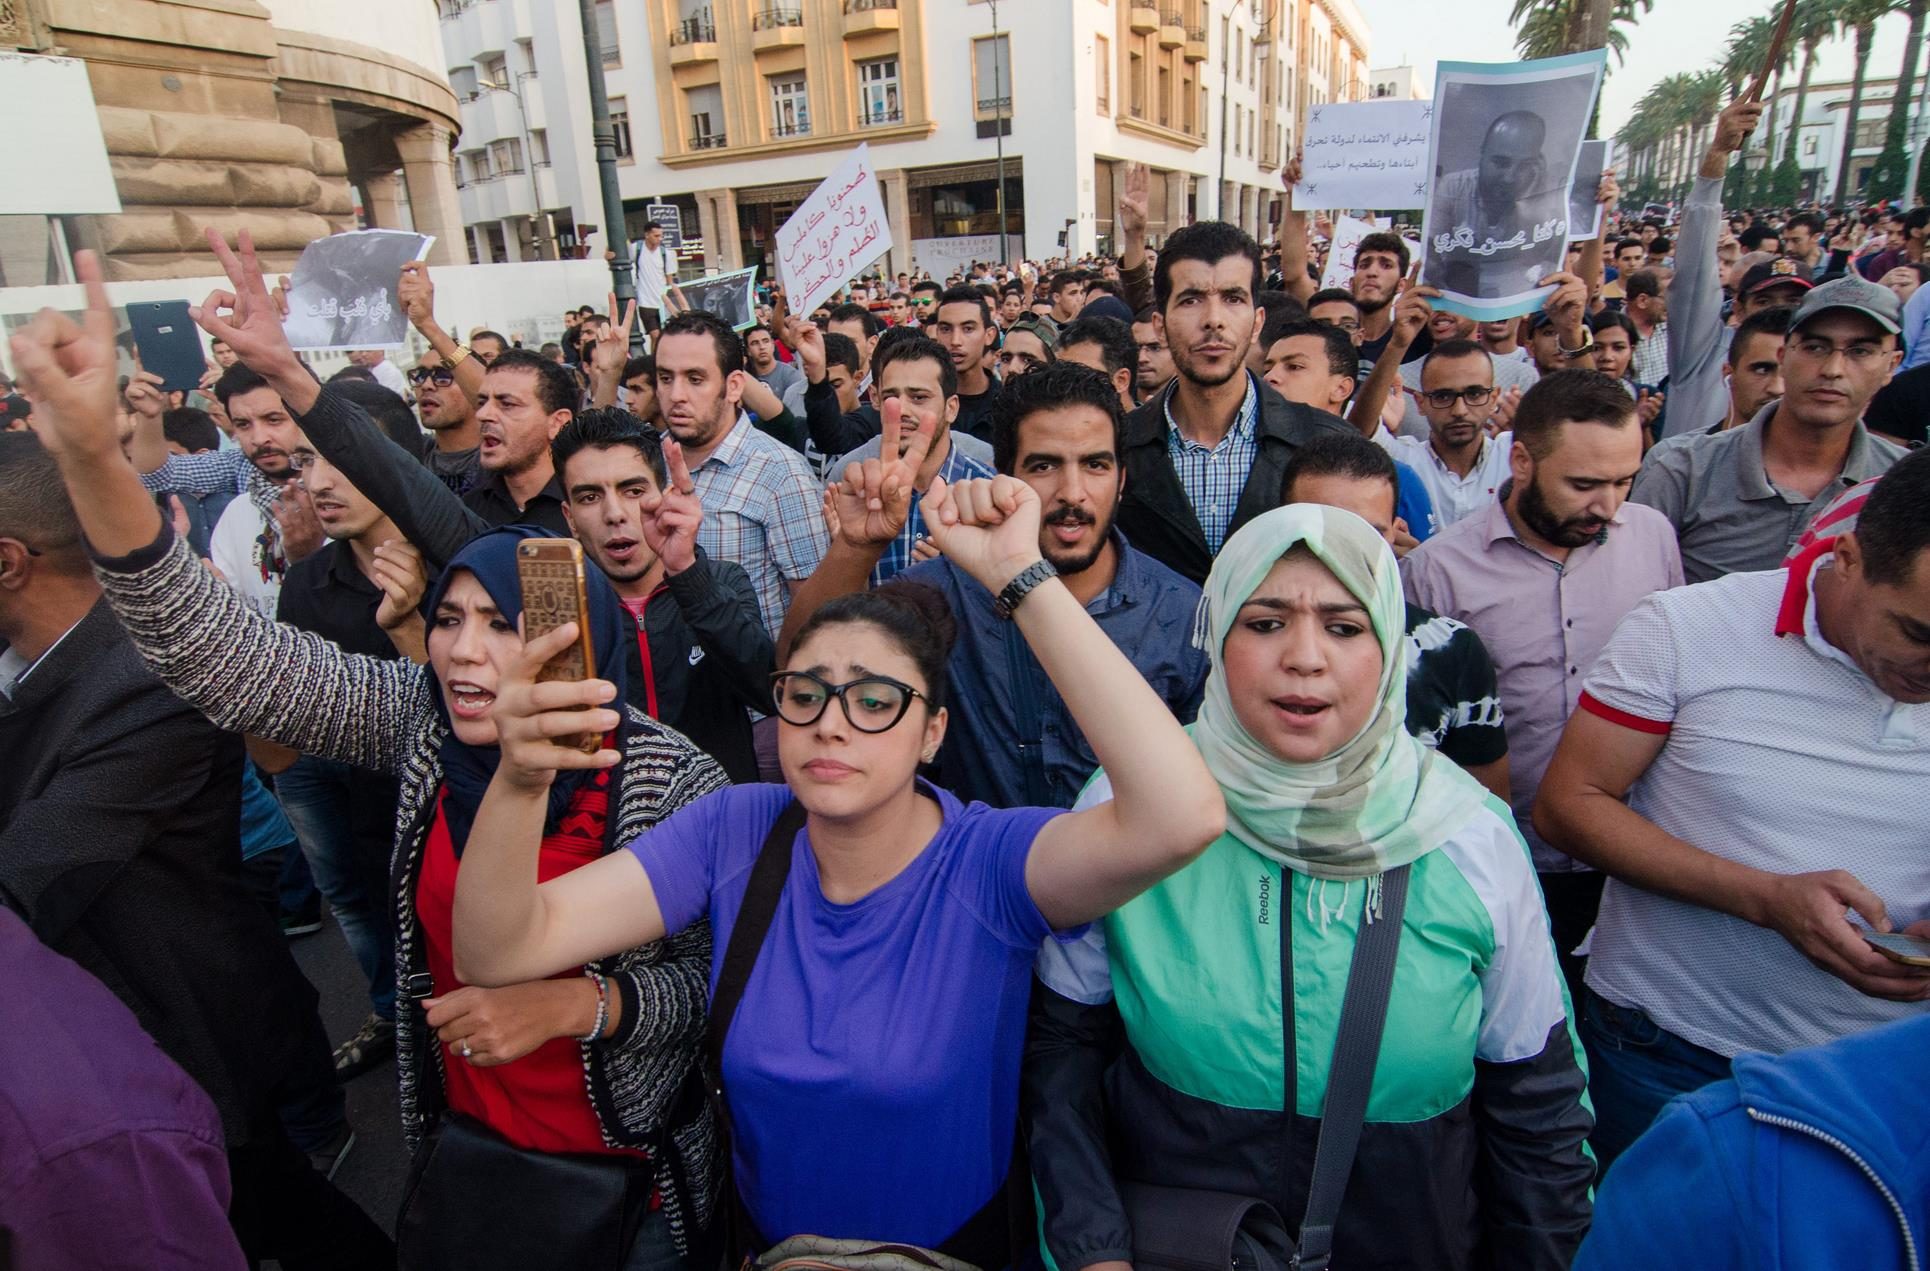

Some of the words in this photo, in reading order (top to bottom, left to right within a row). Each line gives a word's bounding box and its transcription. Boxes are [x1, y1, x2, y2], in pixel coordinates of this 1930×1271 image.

[1305, 135, 1328, 148] تحرق
[1331, 134, 1356, 147] لدولة
[1393, 133, 1426, 148] يشرفني
[1258, 874, 1271, 925] Reebok
